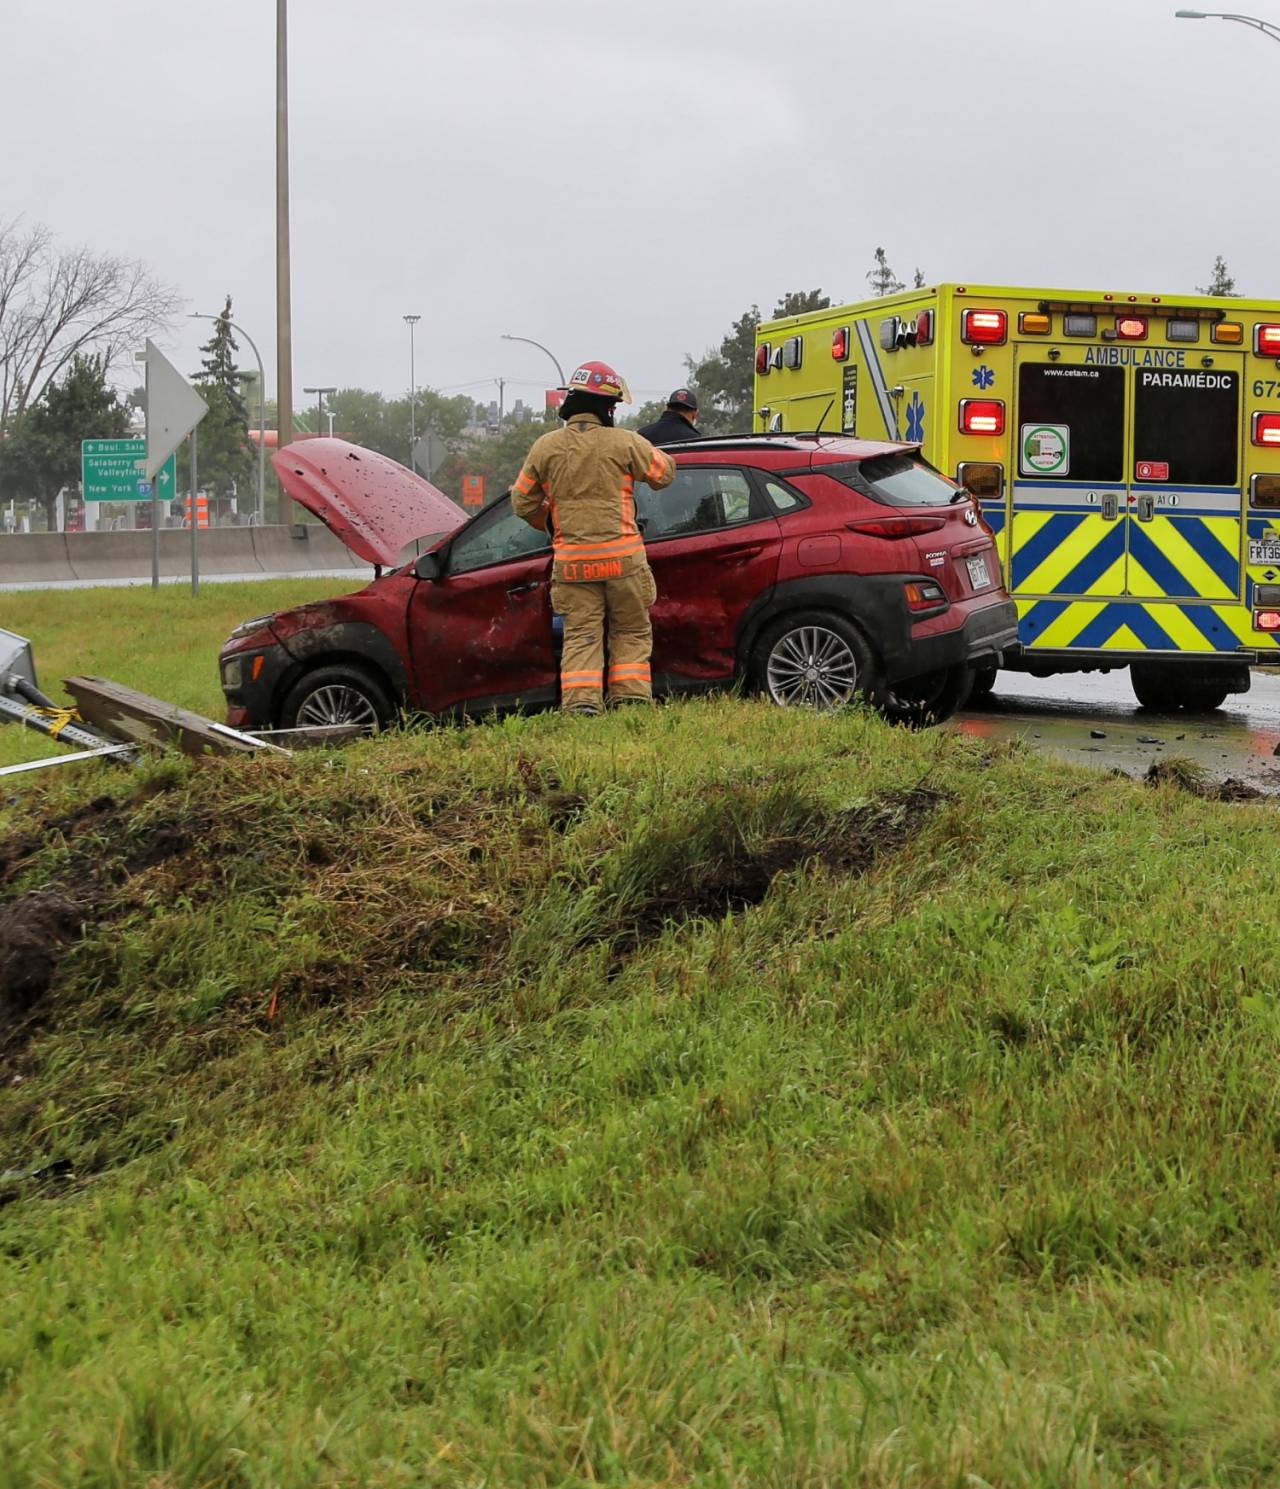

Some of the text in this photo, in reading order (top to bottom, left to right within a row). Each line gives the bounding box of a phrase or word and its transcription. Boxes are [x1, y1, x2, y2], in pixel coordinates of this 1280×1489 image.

[1085, 346, 1186, 369] AMBULANCE
[575, 370, 589, 382] 26
[1043, 368, 1100, 378] www.cetam.ca
[1142, 371, 1232, 390] PARAMÉDIC
[89, 459, 131, 468] Salaberry
[97, 468, 145, 478] Valleyfield
[89, 485, 108, 493] New
[112, 484, 132, 493] York
[563, 560, 622, 580] LT BONIN
